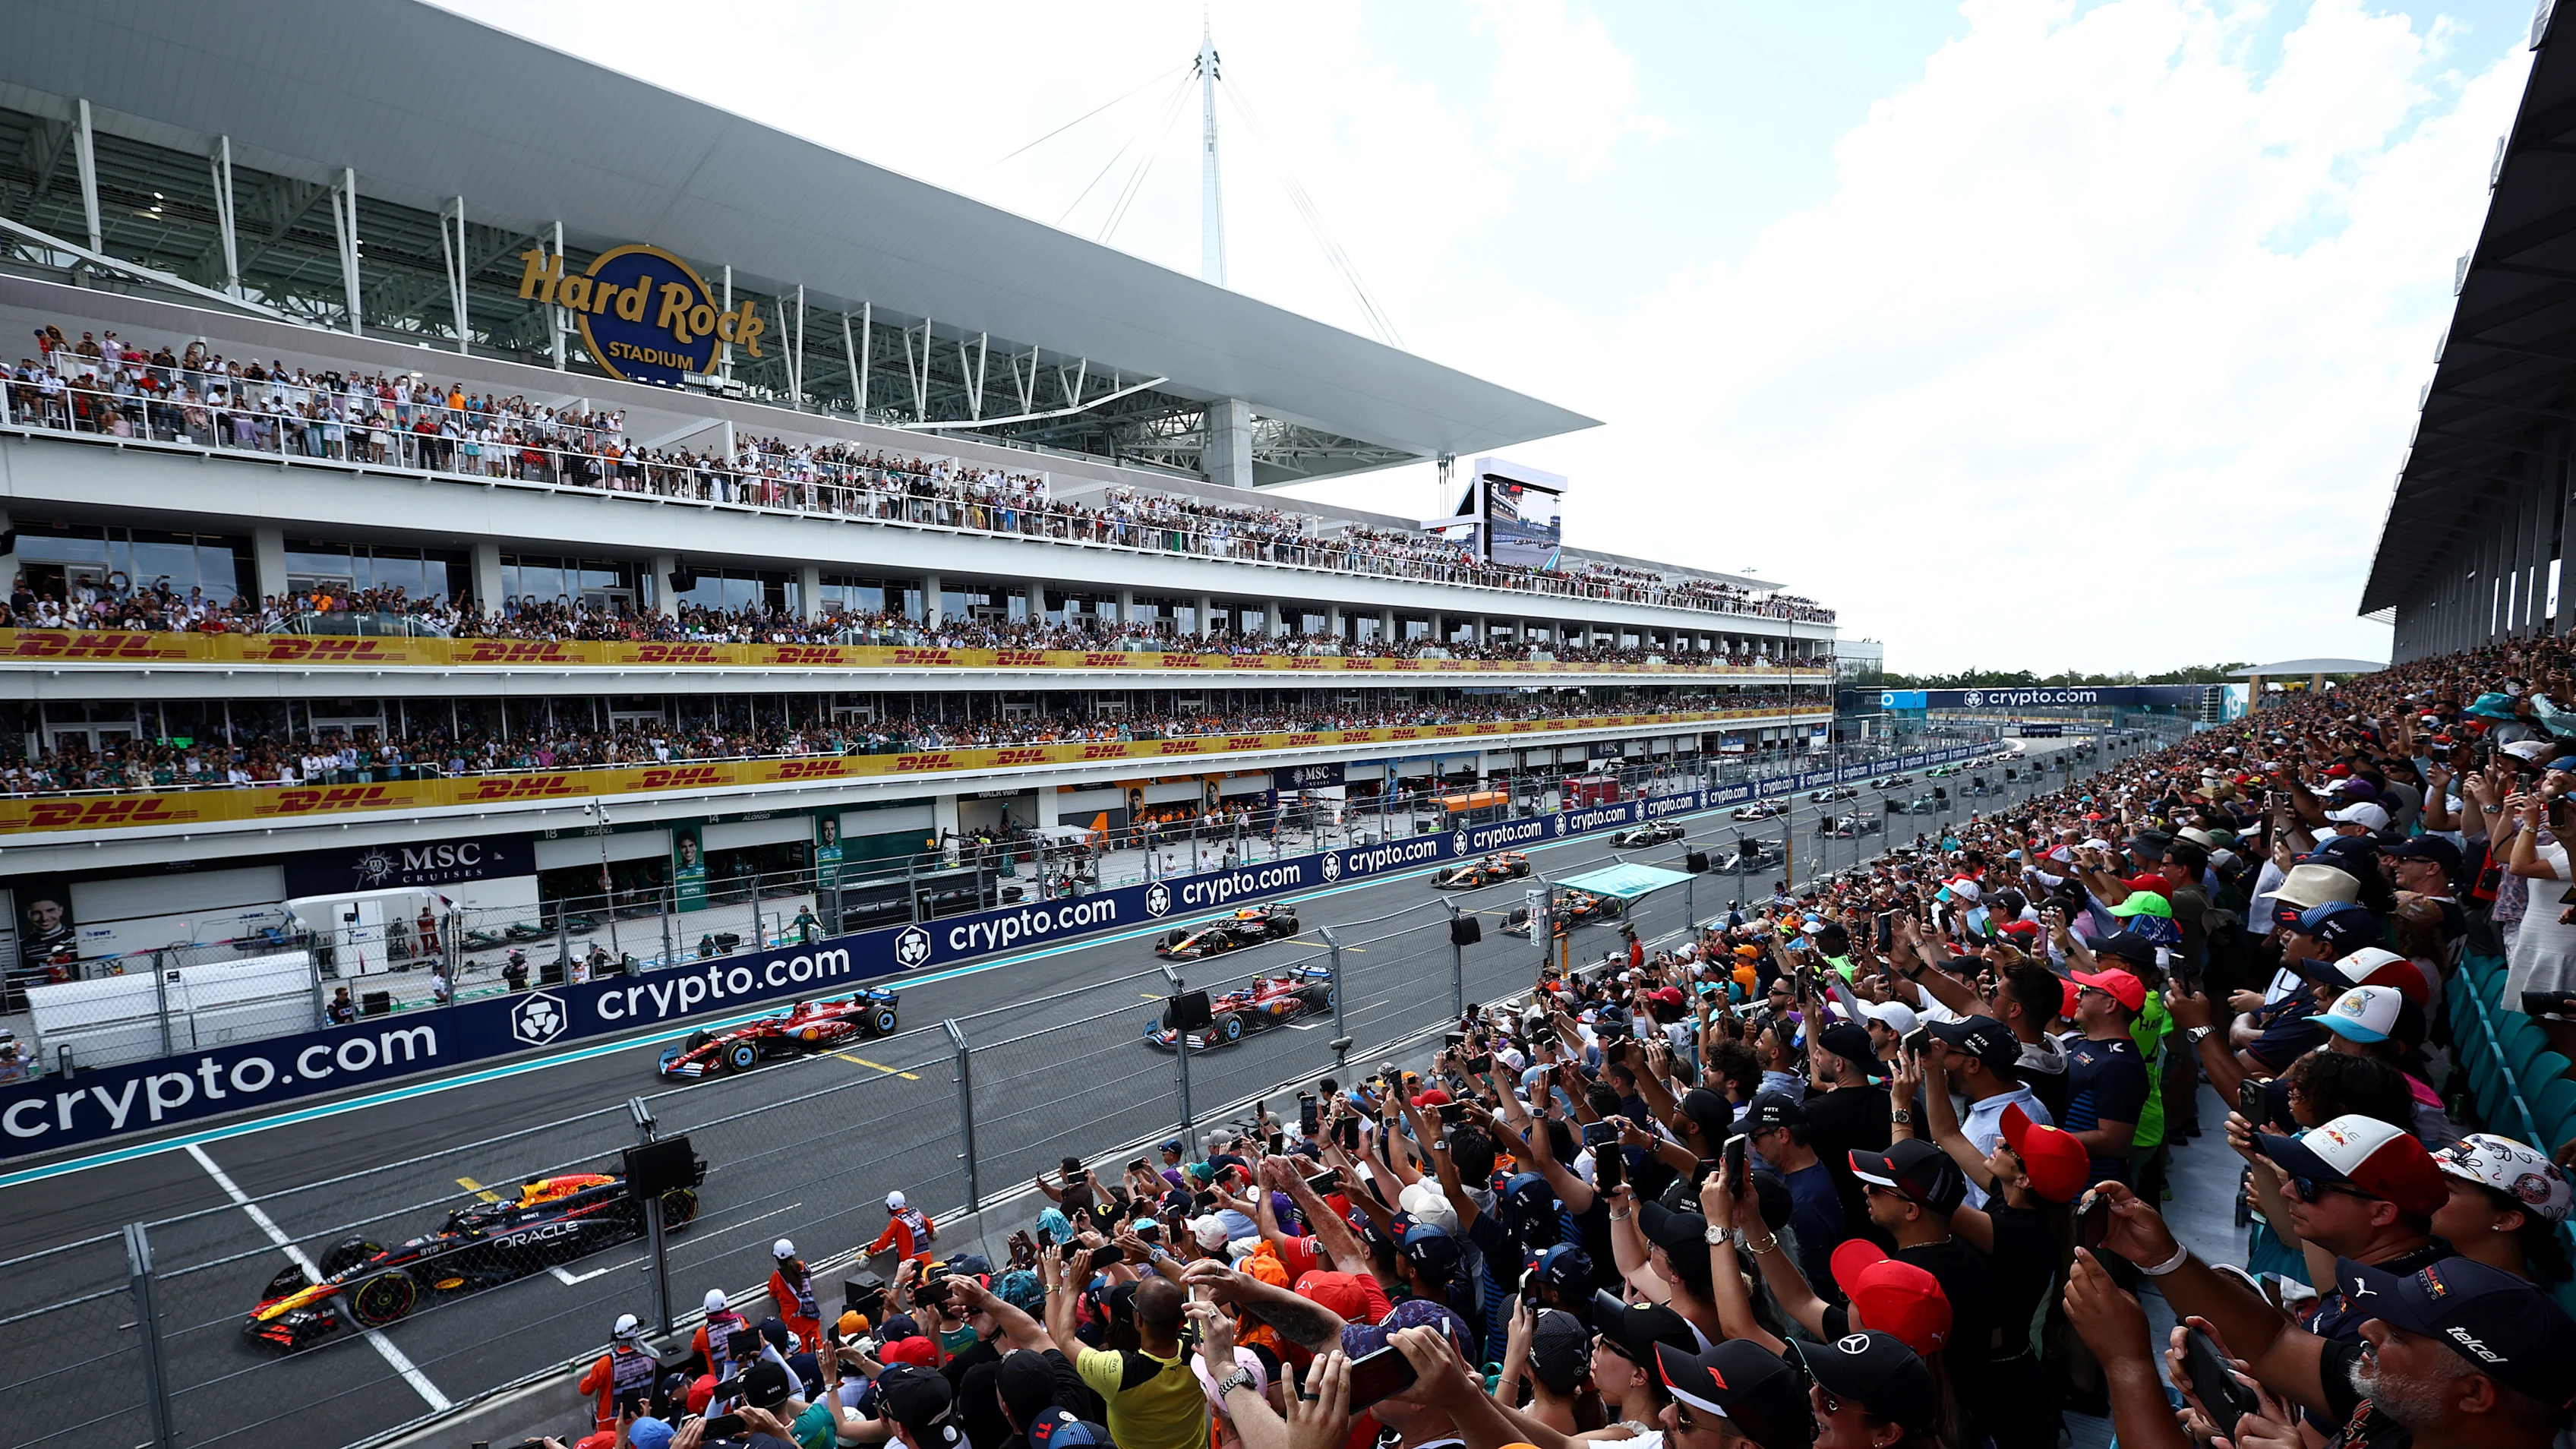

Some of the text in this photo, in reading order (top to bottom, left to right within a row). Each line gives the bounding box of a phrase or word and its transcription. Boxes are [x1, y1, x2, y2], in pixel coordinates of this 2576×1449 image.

[518, 250, 764, 358] Hard Rock
[608, 341, 694, 371] STADIUM
[14, 633, 162, 658] DHL
[267, 639, 385, 660] DHL
[471, 642, 570, 661] DHL
[637, 646, 718, 662] DHL
[776, 648, 844, 663] DHL
[895, 649, 952, 665] DHL
[996, 652, 1046, 665] DHL
[1084, 654, 1129, 666] DHL
[1162, 655, 1201, 667] DHL
[1230, 657, 1265, 668] DHL
[1989, 688, 2097, 706] crypto.com
[2225, 695, 2241, 720] 19
[1160, 741, 1199, 753] DHL
[1228, 737, 1263, 750] DHL
[1288, 734, 1318, 746] DHL
[996, 750, 1047, 764] DHL
[1084, 745, 1128, 759] DHL
[779, 760, 846, 778] DHL
[897, 755, 954, 771] DHL
[642, 767, 721, 788] DHL
[1305, 766, 1329, 780] MSC
[1807, 771, 1833, 787] crypto.com
[1843, 766, 1867, 778] crypto.com
[477, 777, 573, 799] DHL
[977, 789, 1019, 798] WALKWAY
[278, 788, 394, 812] DHL
[1710, 786, 1748, 807] crypto.com
[29, 798, 173, 826] DHL
[1648, 795, 1694, 819] crypto.com
[742, 813, 771, 822] ALONSO
[1571, 807, 1626, 834] crypto.com
[545, 829, 557, 840] 18
[584, 827, 614, 836] STROLL
[1473, 821, 1542, 848] crypto.com
[401, 842, 481, 872] MSC
[1349, 840, 1437, 873] crypto.com
[403, 869, 482, 883] CRUISES
[1182, 863, 1301, 906] crypto.com
[2279, 911, 2297, 922] 11
[949, 898, 1116, 952] crypto.com
[2326, 919, 2347, 933] telcel
[597, 948, 850, 1018] crypto.com
[1977, 1036, 1990, 1047] FTX
[2, 1025, 437, 1138] crypto.com
[1494, 1179, 1504, 1190] 11
[494, 1220, 579, 1249] ORACLE
[1393, 1221, 1406, 1236] 11
[1551, 1266, 1566, 1278] telcel
[1028, 1294, 1041, 1302] BOSS
[2445, 1326, 2508, 1364] telcel
[1111, 1358, 1119, 1374] aws
[766, 1384, 781, 1394] BOSS
[1035, 1422, 1053, 1440] 11
